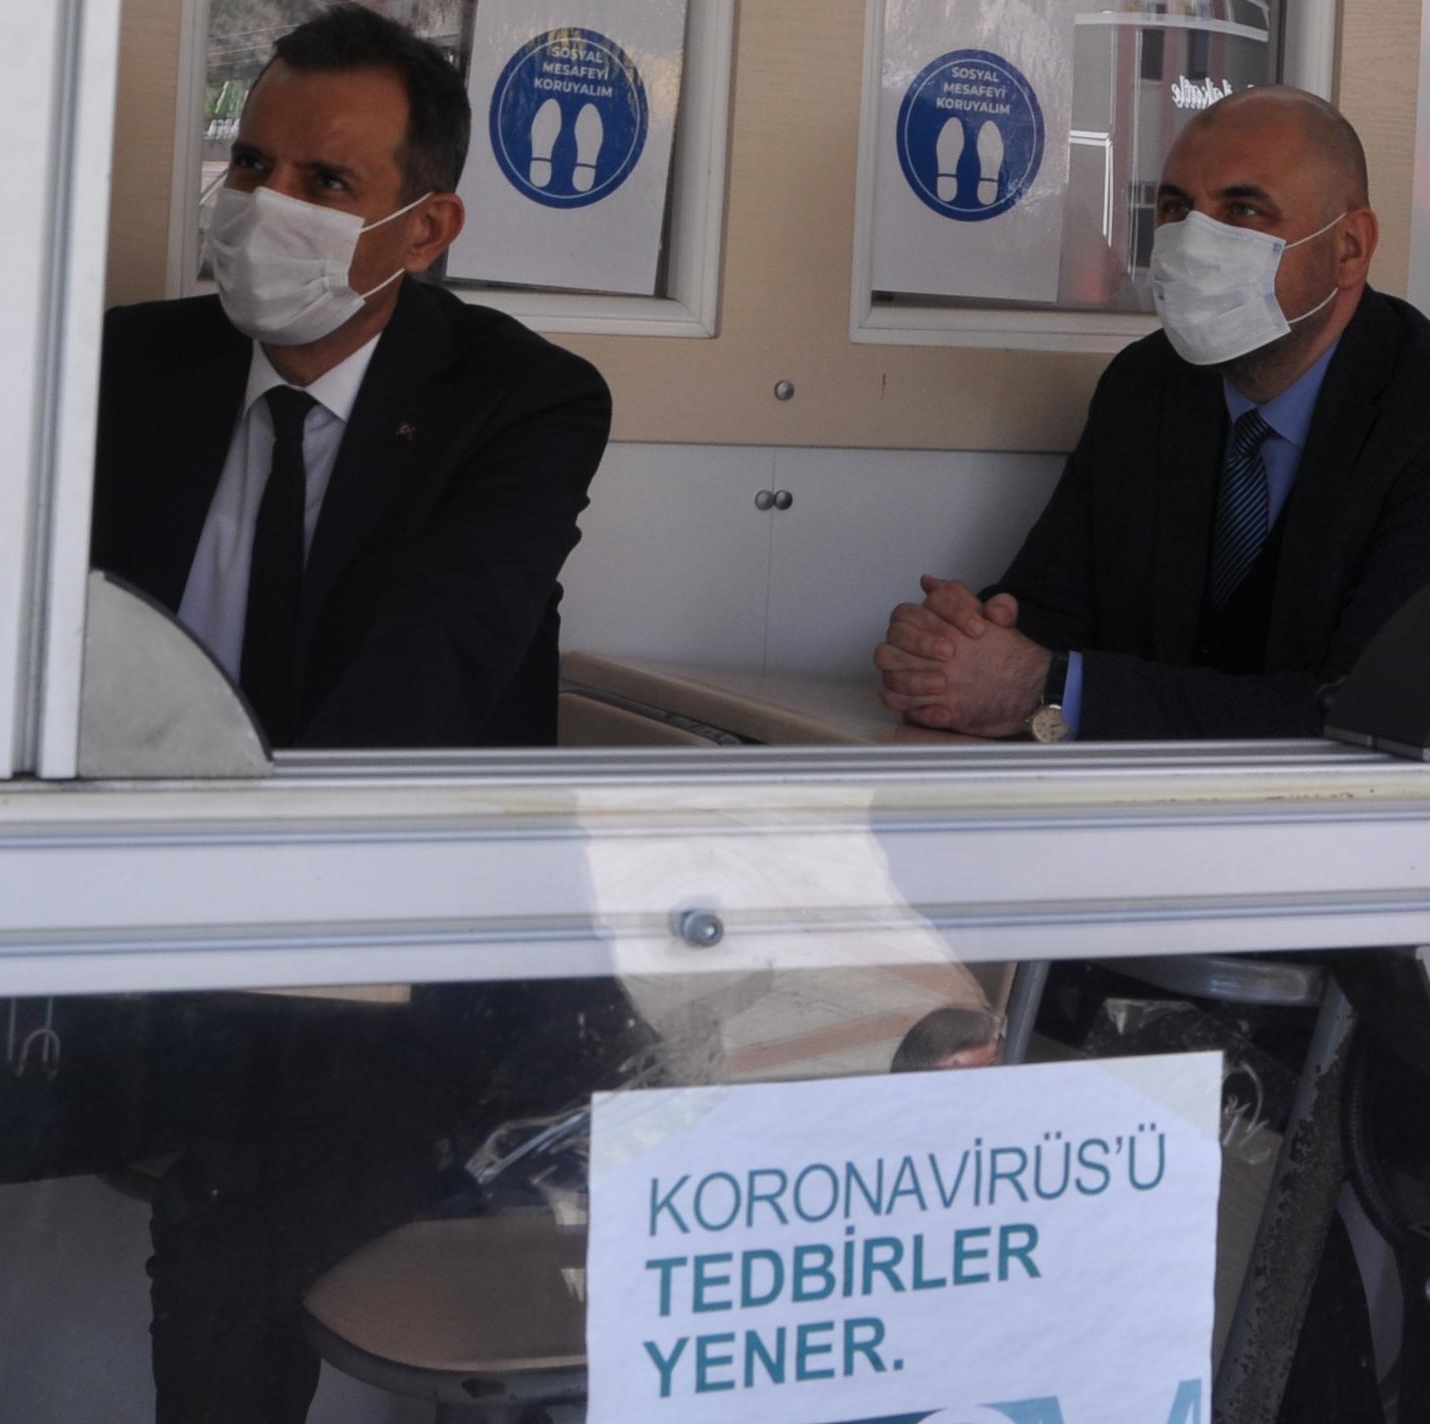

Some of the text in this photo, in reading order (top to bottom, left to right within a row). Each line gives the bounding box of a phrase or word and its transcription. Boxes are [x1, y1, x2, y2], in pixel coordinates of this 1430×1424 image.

[552, 46, 602, 63] SOSYAL
[542, 62, 609, 80] MESAFEYİ
[952, 67, 1000, 82] SOSYAL
[534, 78, 613, 97] KORUYALIM
[943, 83, 1006, 98] MESAFEYİ
[936, 97, 1011, 114] KORUYALIM
[649, 1123, 1166, 1237] KORONAVİRÜS'Ü
[645, 1223, 1042, 1317] TEDBİRLER
[642, 1316, 905, 1399] YENER.
